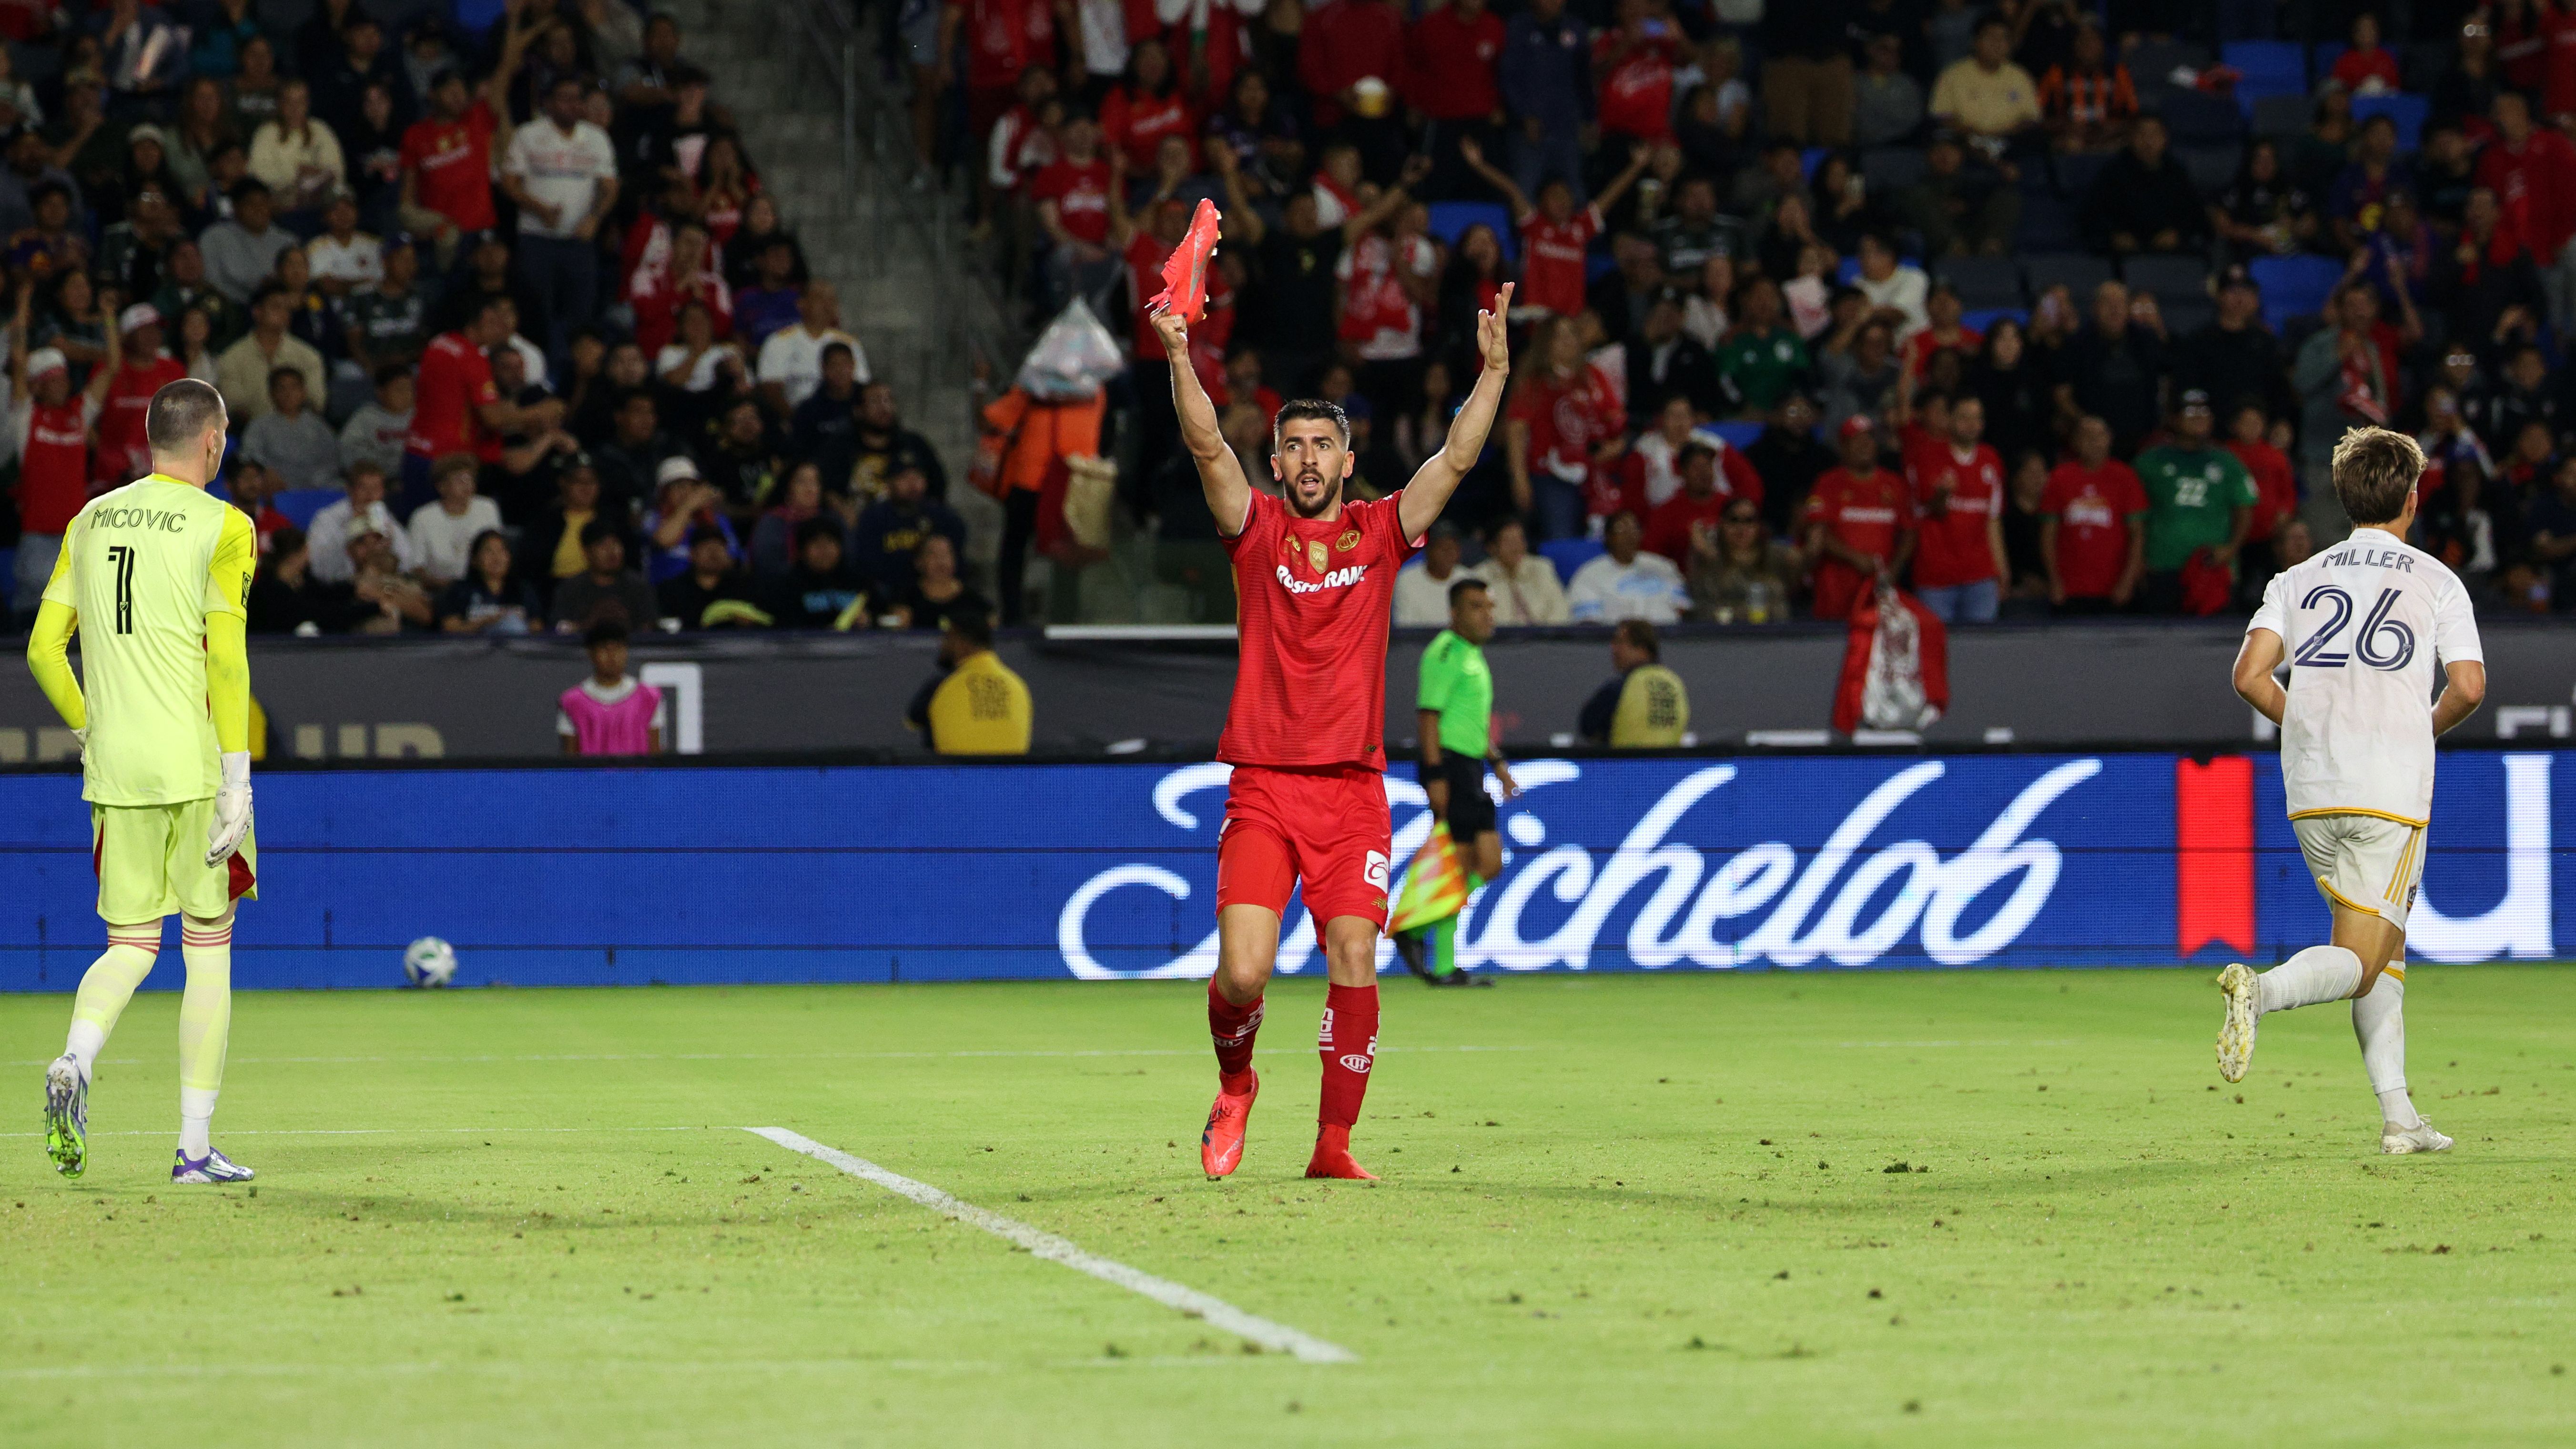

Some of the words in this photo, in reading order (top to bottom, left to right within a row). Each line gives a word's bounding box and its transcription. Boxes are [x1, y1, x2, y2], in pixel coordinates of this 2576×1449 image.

[108, 546, 135, 635] 1
[2322, 548, 2414, 573] MILLER
[2294, 584, 2415, 671] 26
